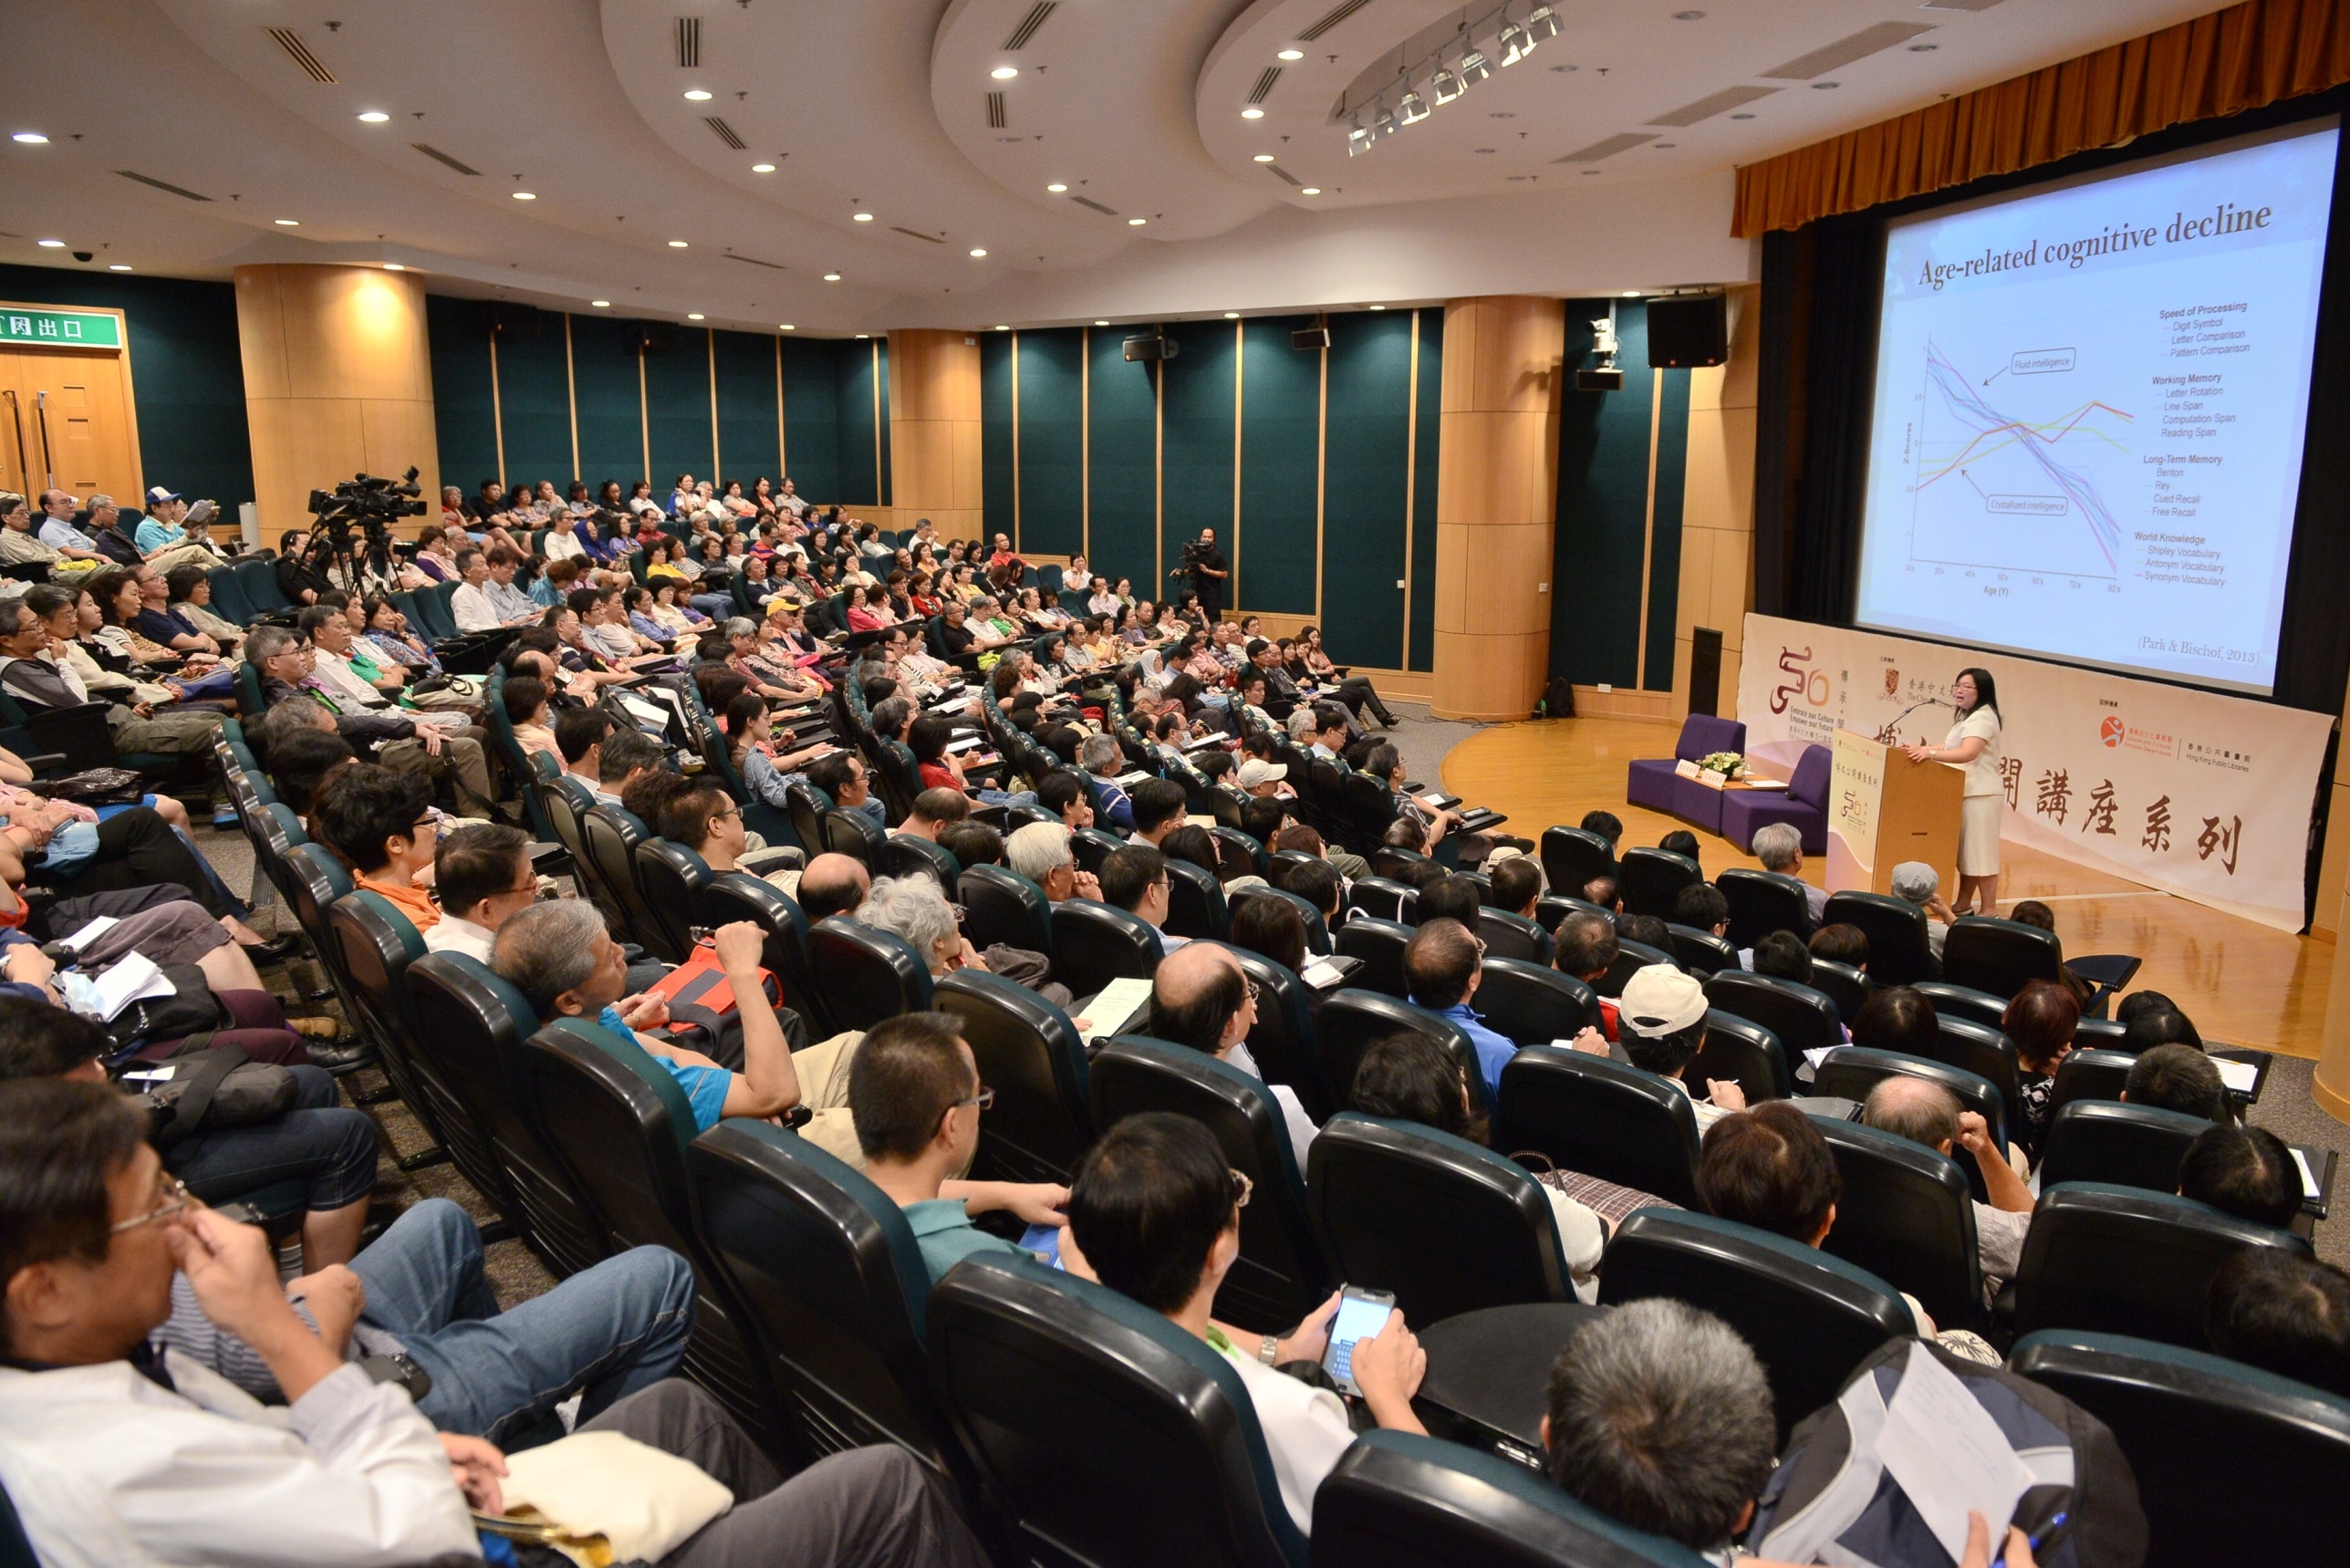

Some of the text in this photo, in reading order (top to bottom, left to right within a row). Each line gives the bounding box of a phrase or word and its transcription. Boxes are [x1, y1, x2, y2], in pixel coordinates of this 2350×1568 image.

[1918, 202, 2272, 290] Age-related cognitive decline
[2159, 302, 2248, 319] Speed of Processing
[37, 318, 82, 338] 出口
[2173, 317, 2223, 332] Digit Symbol
[2171, 330, 2245, 345] Letter Comparison
[2170, 344, 2250, 358] Pattern Comparison
[2014, 357, 2070, 369] Fluid intelligence
[2152, 374, 2221, 386] Working Memory
[2166, 387, 2223, 398] Letter Rotation
[2164, 401, 2203, 412] Line Span
[2163, 413, 2235, 425] Computation Span
[2161, 427, 2216, 439] Reading Span
[2143, 454, 2222, 466] Long-Term Memory
[2157, 467, 2183, 477] Benton
[2155, 481, 2170, 492] Rey
[2154, 493, 2200, 504] Cued Recall
[1991, 499, 2065, 512] Crystallized intelligence
[2152, 507, 2196, 517] Free Recall
[2135, 532, 2206, 545] World Knowledge
[2148, 545, 2221, 561] Shipley Vocabulary
[2146, 558, 2225, 575] Antonym Vocabulary
[2145, 571, 2226, 588] Synonym Vocabulary
[1984, 585, 2009, 597] Age (Y)
[2137, 636, 2261, 668] (Park & Bischof, 2013)
[1790, 706, 1834, 724] Embrace our Culture
[1790, 714, 1807, 725] Empower
[1819, 722, 1834, 732] Future
[2186, 752, 2250, 773] Hong Kong Public Libraries
